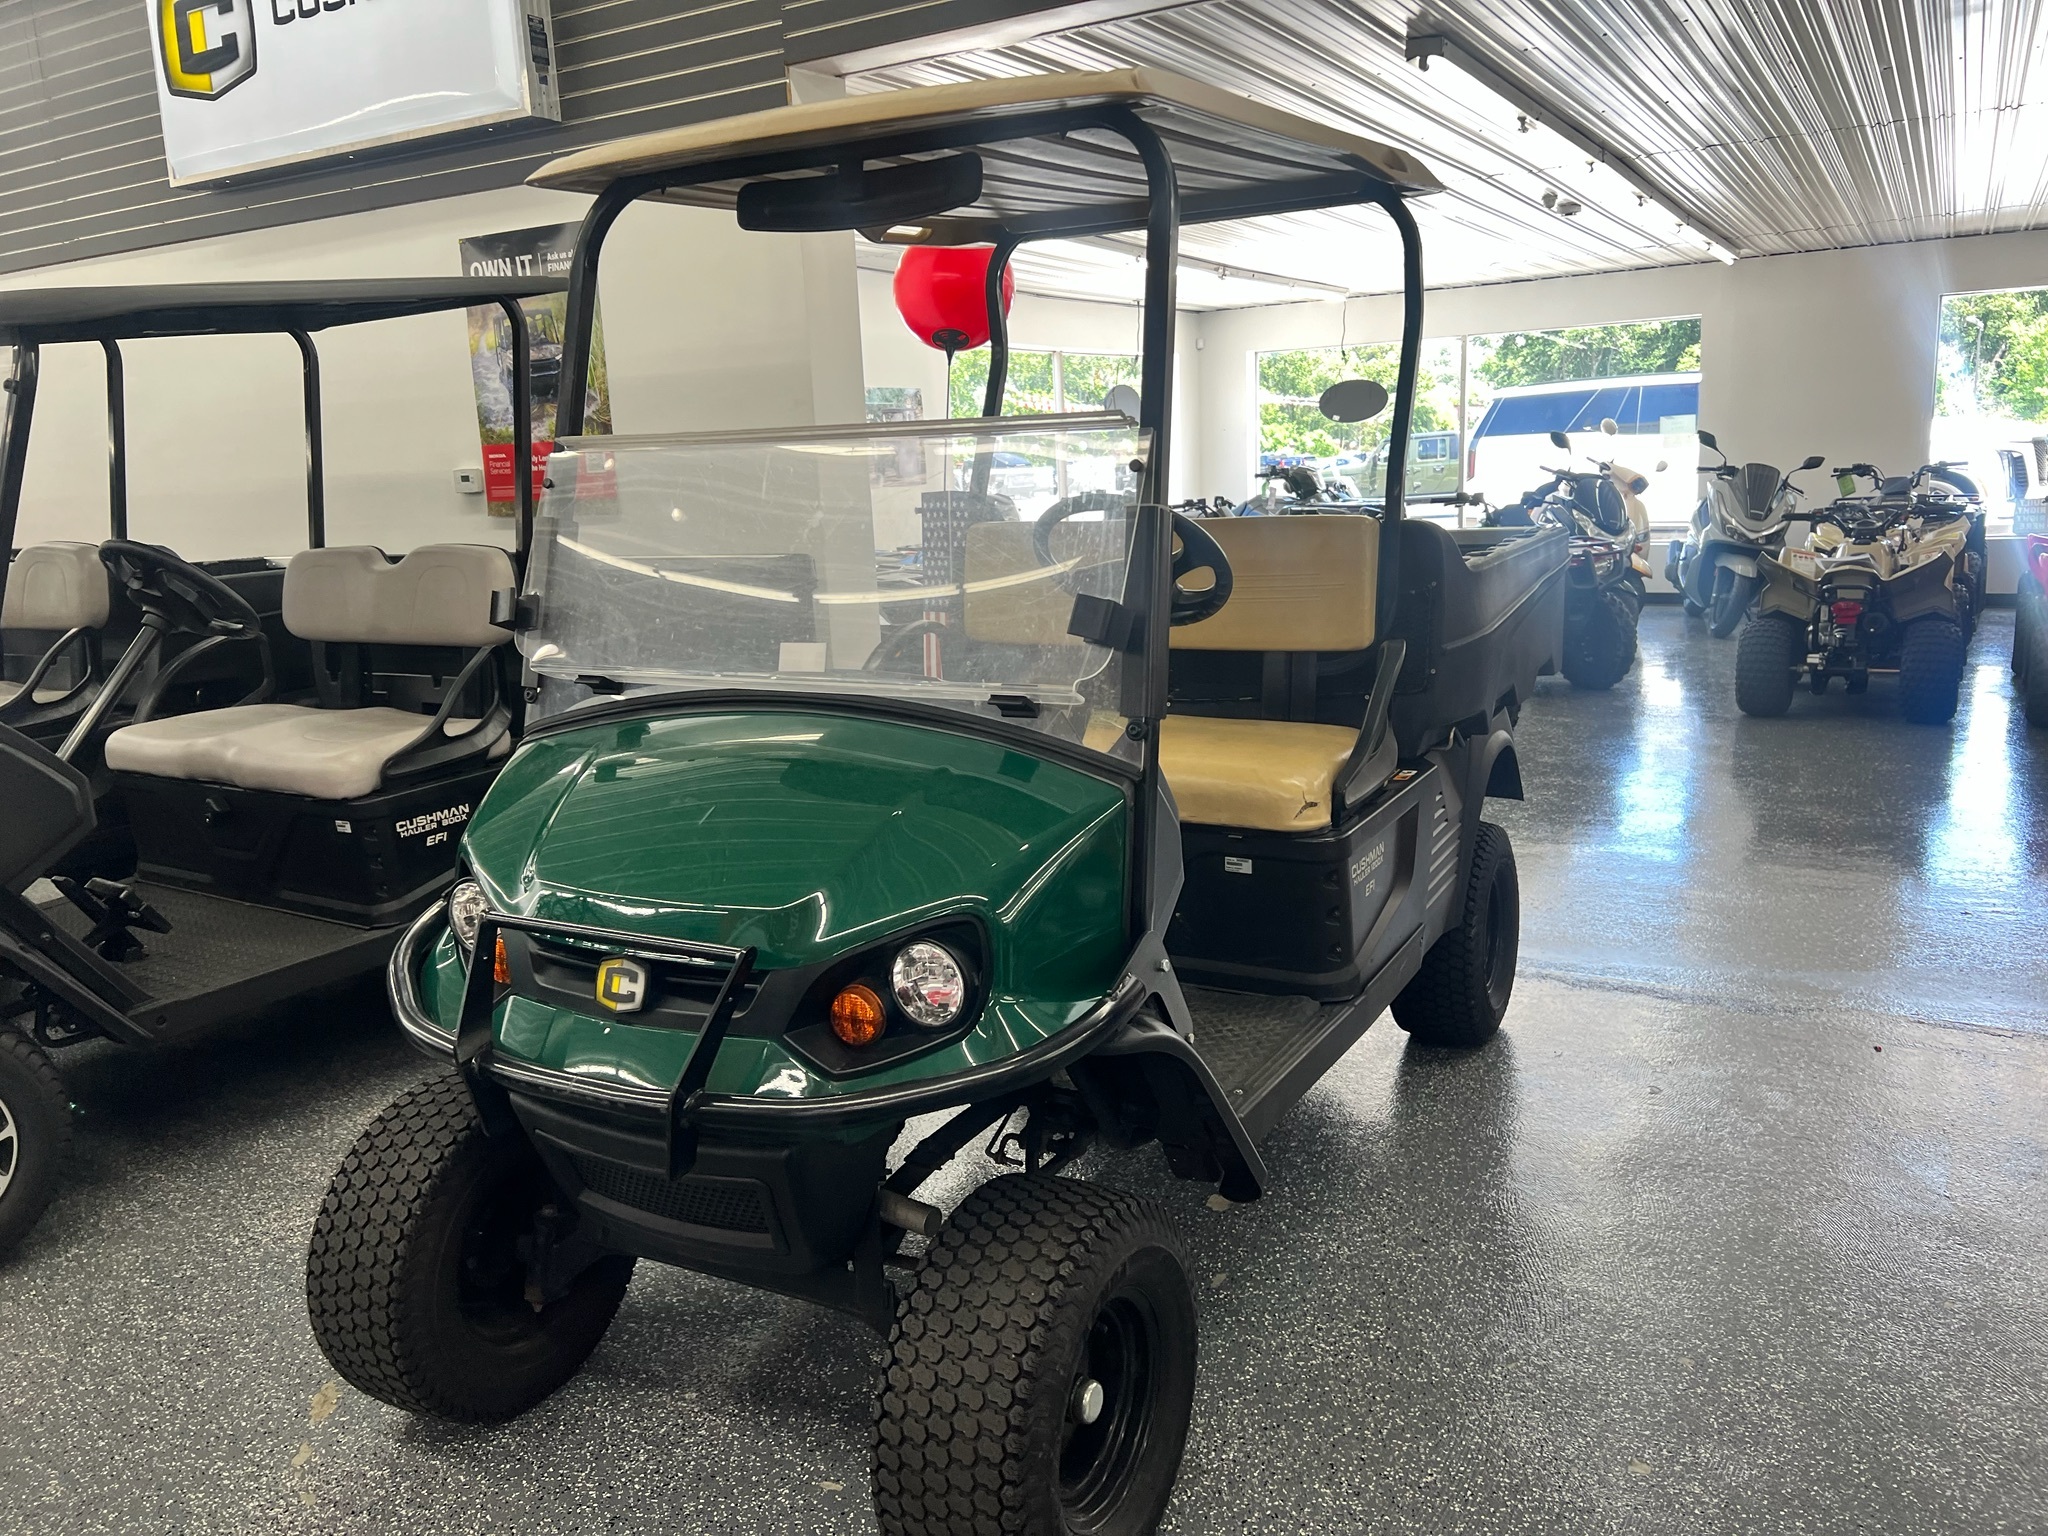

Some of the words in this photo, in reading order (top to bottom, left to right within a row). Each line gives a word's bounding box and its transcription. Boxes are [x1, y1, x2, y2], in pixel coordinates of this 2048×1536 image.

[470, 257, 513, 277] OWN
[515, 254, 533, 277] IT
[547, 252, 559, 261] Ask
[489, 460, 511, 468] Financial
[395, 803, 470, 833] CUSHMAN
[400, 822, 438, 838] HAULER
[441, 813, 468, 826] 800X
[426, 831, 448, 847] EFI
[1351, 841, 1385, 879] CUSHMAN
[1365, 878, 1376, 897] EFI
